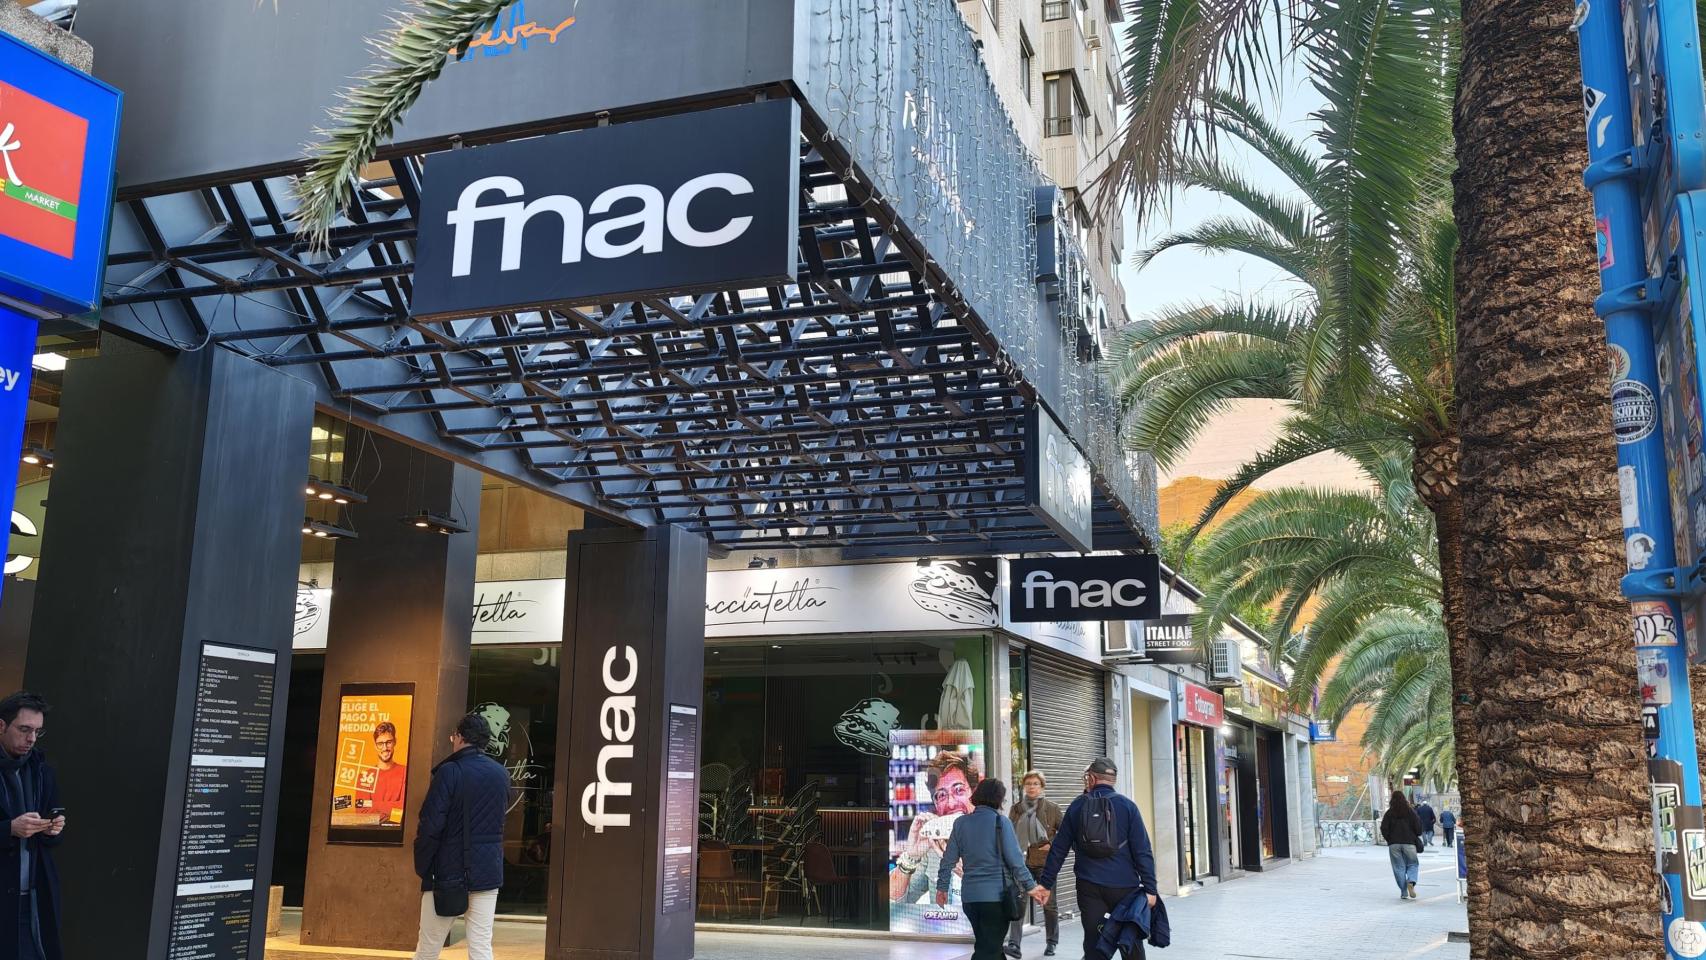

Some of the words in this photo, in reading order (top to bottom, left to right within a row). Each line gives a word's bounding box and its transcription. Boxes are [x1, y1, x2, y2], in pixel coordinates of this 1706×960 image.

[25, 191, 60, 210] MARKET
[447, 172, 754, 277] fnac
[1022, 570, 1146, 609] fnac
[341, 702, 368, 712] ELIGE
[369, 702, 379, 712] EL
[340, 713, 367, 722] PAGO
[369, 713, 376, 722] A
[378, 713, 390, 722] TU
[339, 723, 376, 733] MEDIDA
[581, 645, 638, 833] fnac
[349, 744, 357, 755] 3
[340, 768, 356, 779] 20
[360, 770, 375, 784] 36
